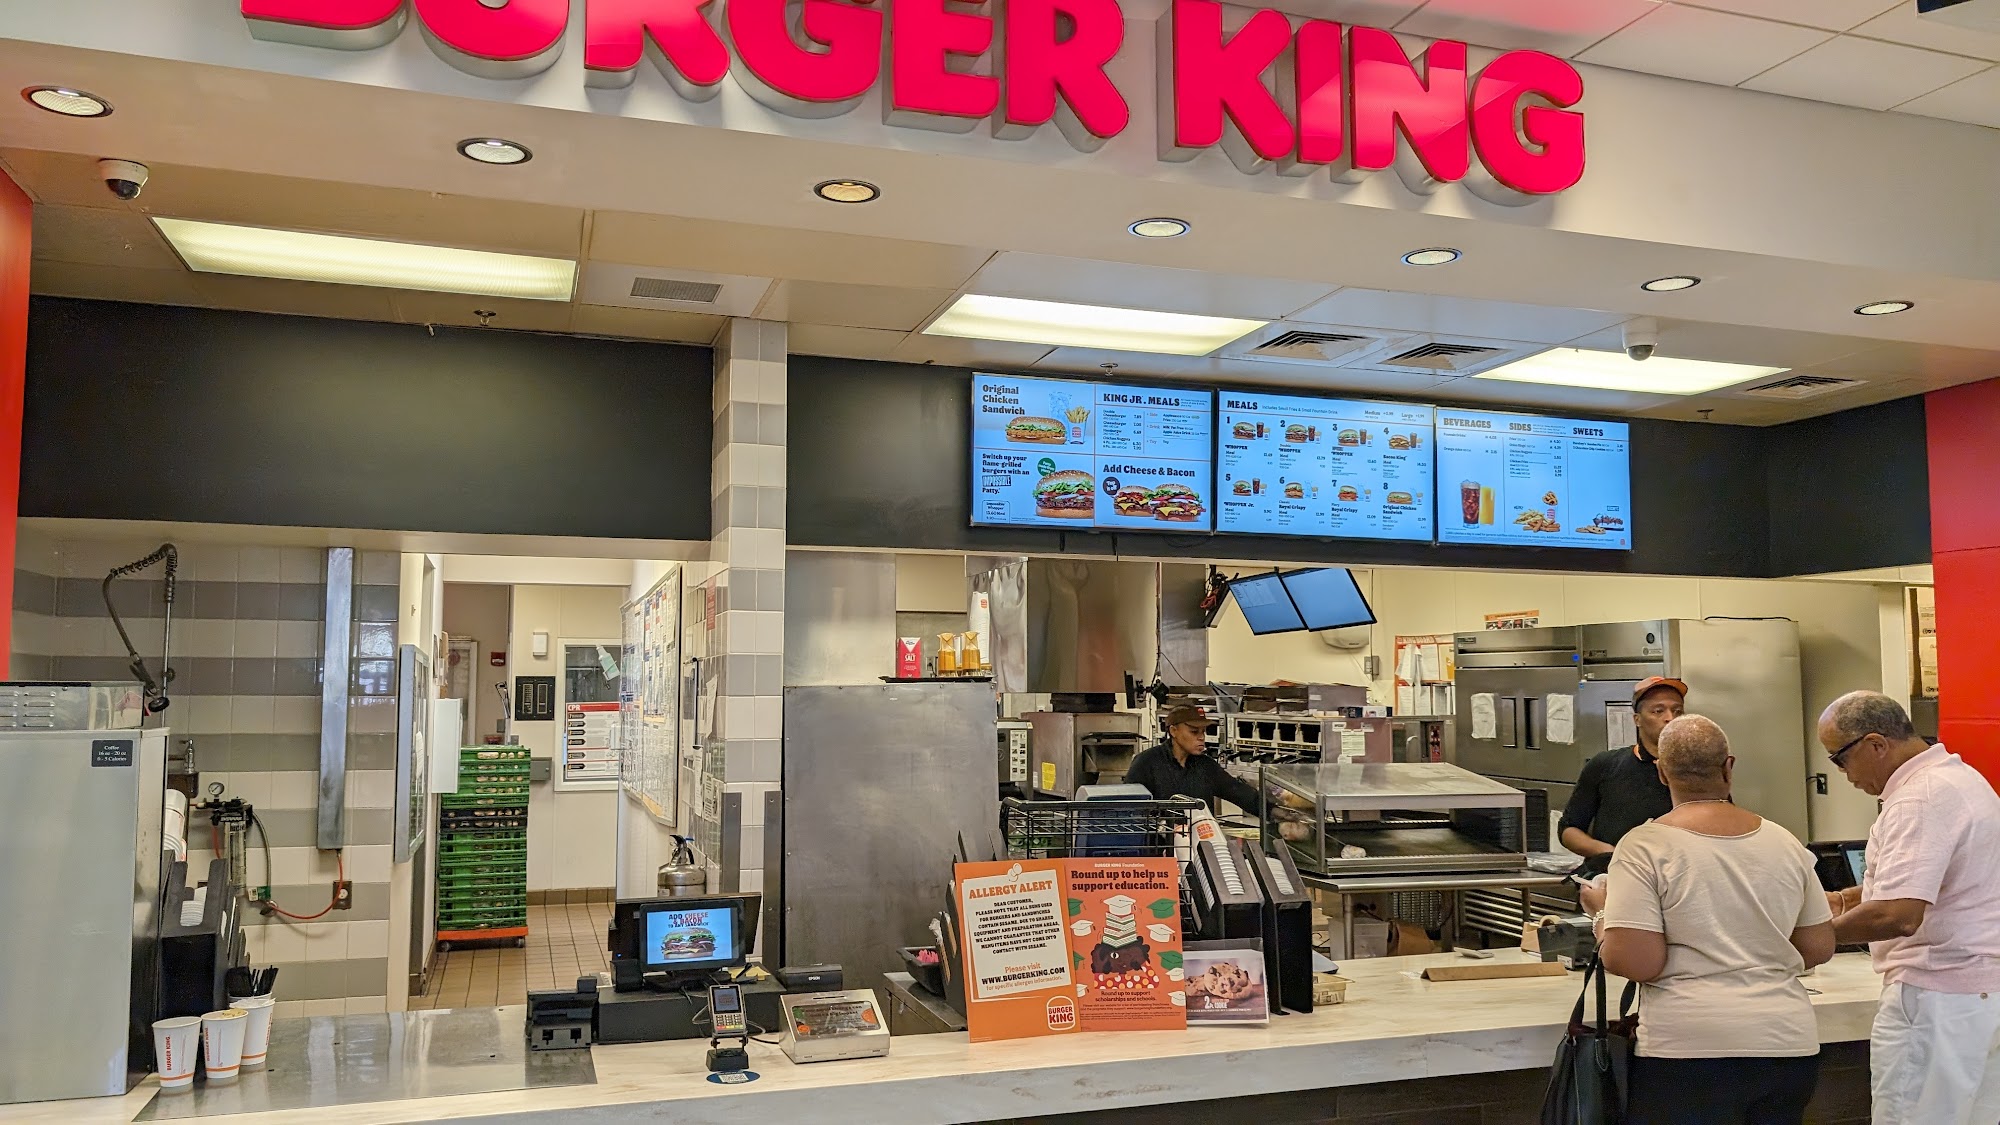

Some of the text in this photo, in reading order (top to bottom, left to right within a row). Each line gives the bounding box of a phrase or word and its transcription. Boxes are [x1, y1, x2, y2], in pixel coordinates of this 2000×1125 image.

[241, 0, 1586, 195] GER KING
[983, 385, 1019, 395] Original
[983, 395, 1018, 404] Chicken
[1104, 394, 1127, 403] KING
[1148, 397, 1180, 406] MEALS
[1227, 400, 1258, 410] MEALS
[982, 405, 1025, 414] Sandwich
[1444, 418, 1491, 428] BEVERAGES
[1509, 423, 1531, 431] SIDES
[1573, 428, 1603, 436] SWEETS
[1103, 464, 1195, 476] Add Cheese & Bacon
[1071, 870, 1104, 879] Round
[1106, 872, 1119, 880] up
[1122, 870, 1131, 878] to
[1133, 870, 1155, 882] help
[969, 880, 1052, 899] ALLERGY ALERT
[1072, 881, 1169, 892] support education.
[1005, 962, 1041, 973] Please visit
[982, 967, 1065, 985] WWW.BURGERKING.COM
[995, 982, 1014, 990] specific
[1034, 976, 1062, 984] information.
[1048, 1006, 1073, 1023] BURGER KING
